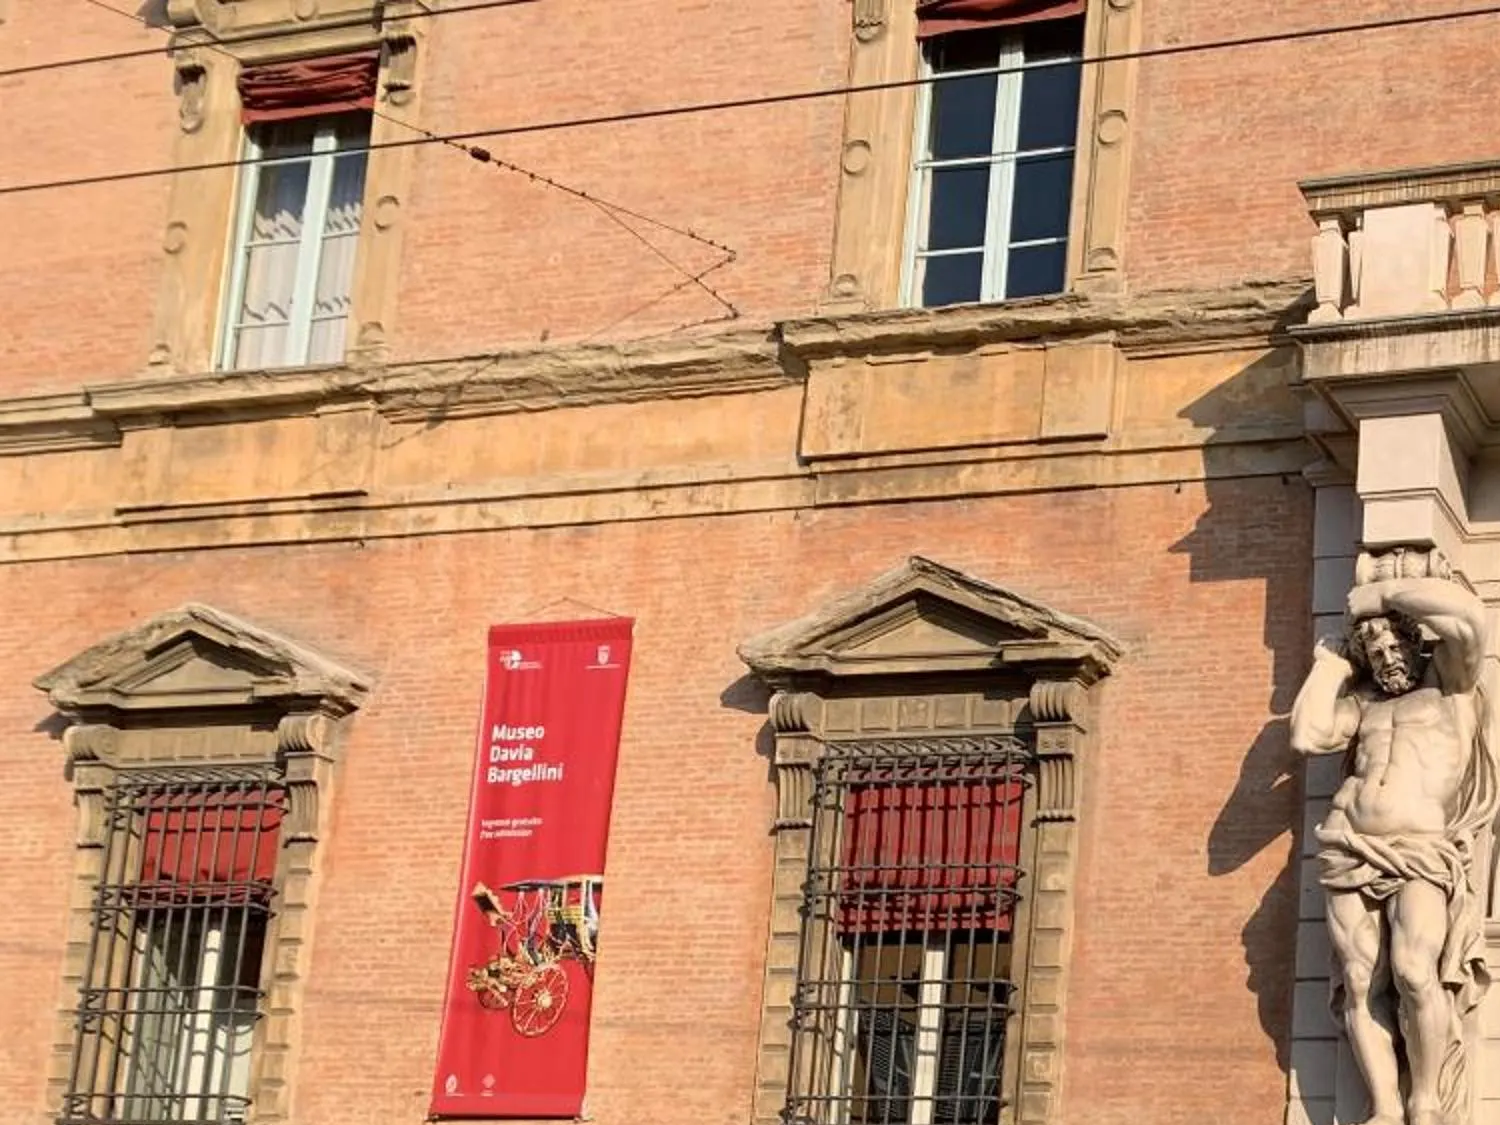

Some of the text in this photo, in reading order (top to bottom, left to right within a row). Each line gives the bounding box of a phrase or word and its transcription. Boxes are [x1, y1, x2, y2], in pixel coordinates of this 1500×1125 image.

[492, 724, 545, 742] Museo
[490, 743, 533, 763] Davia
[487, 762, 564, 787] Bargellini
